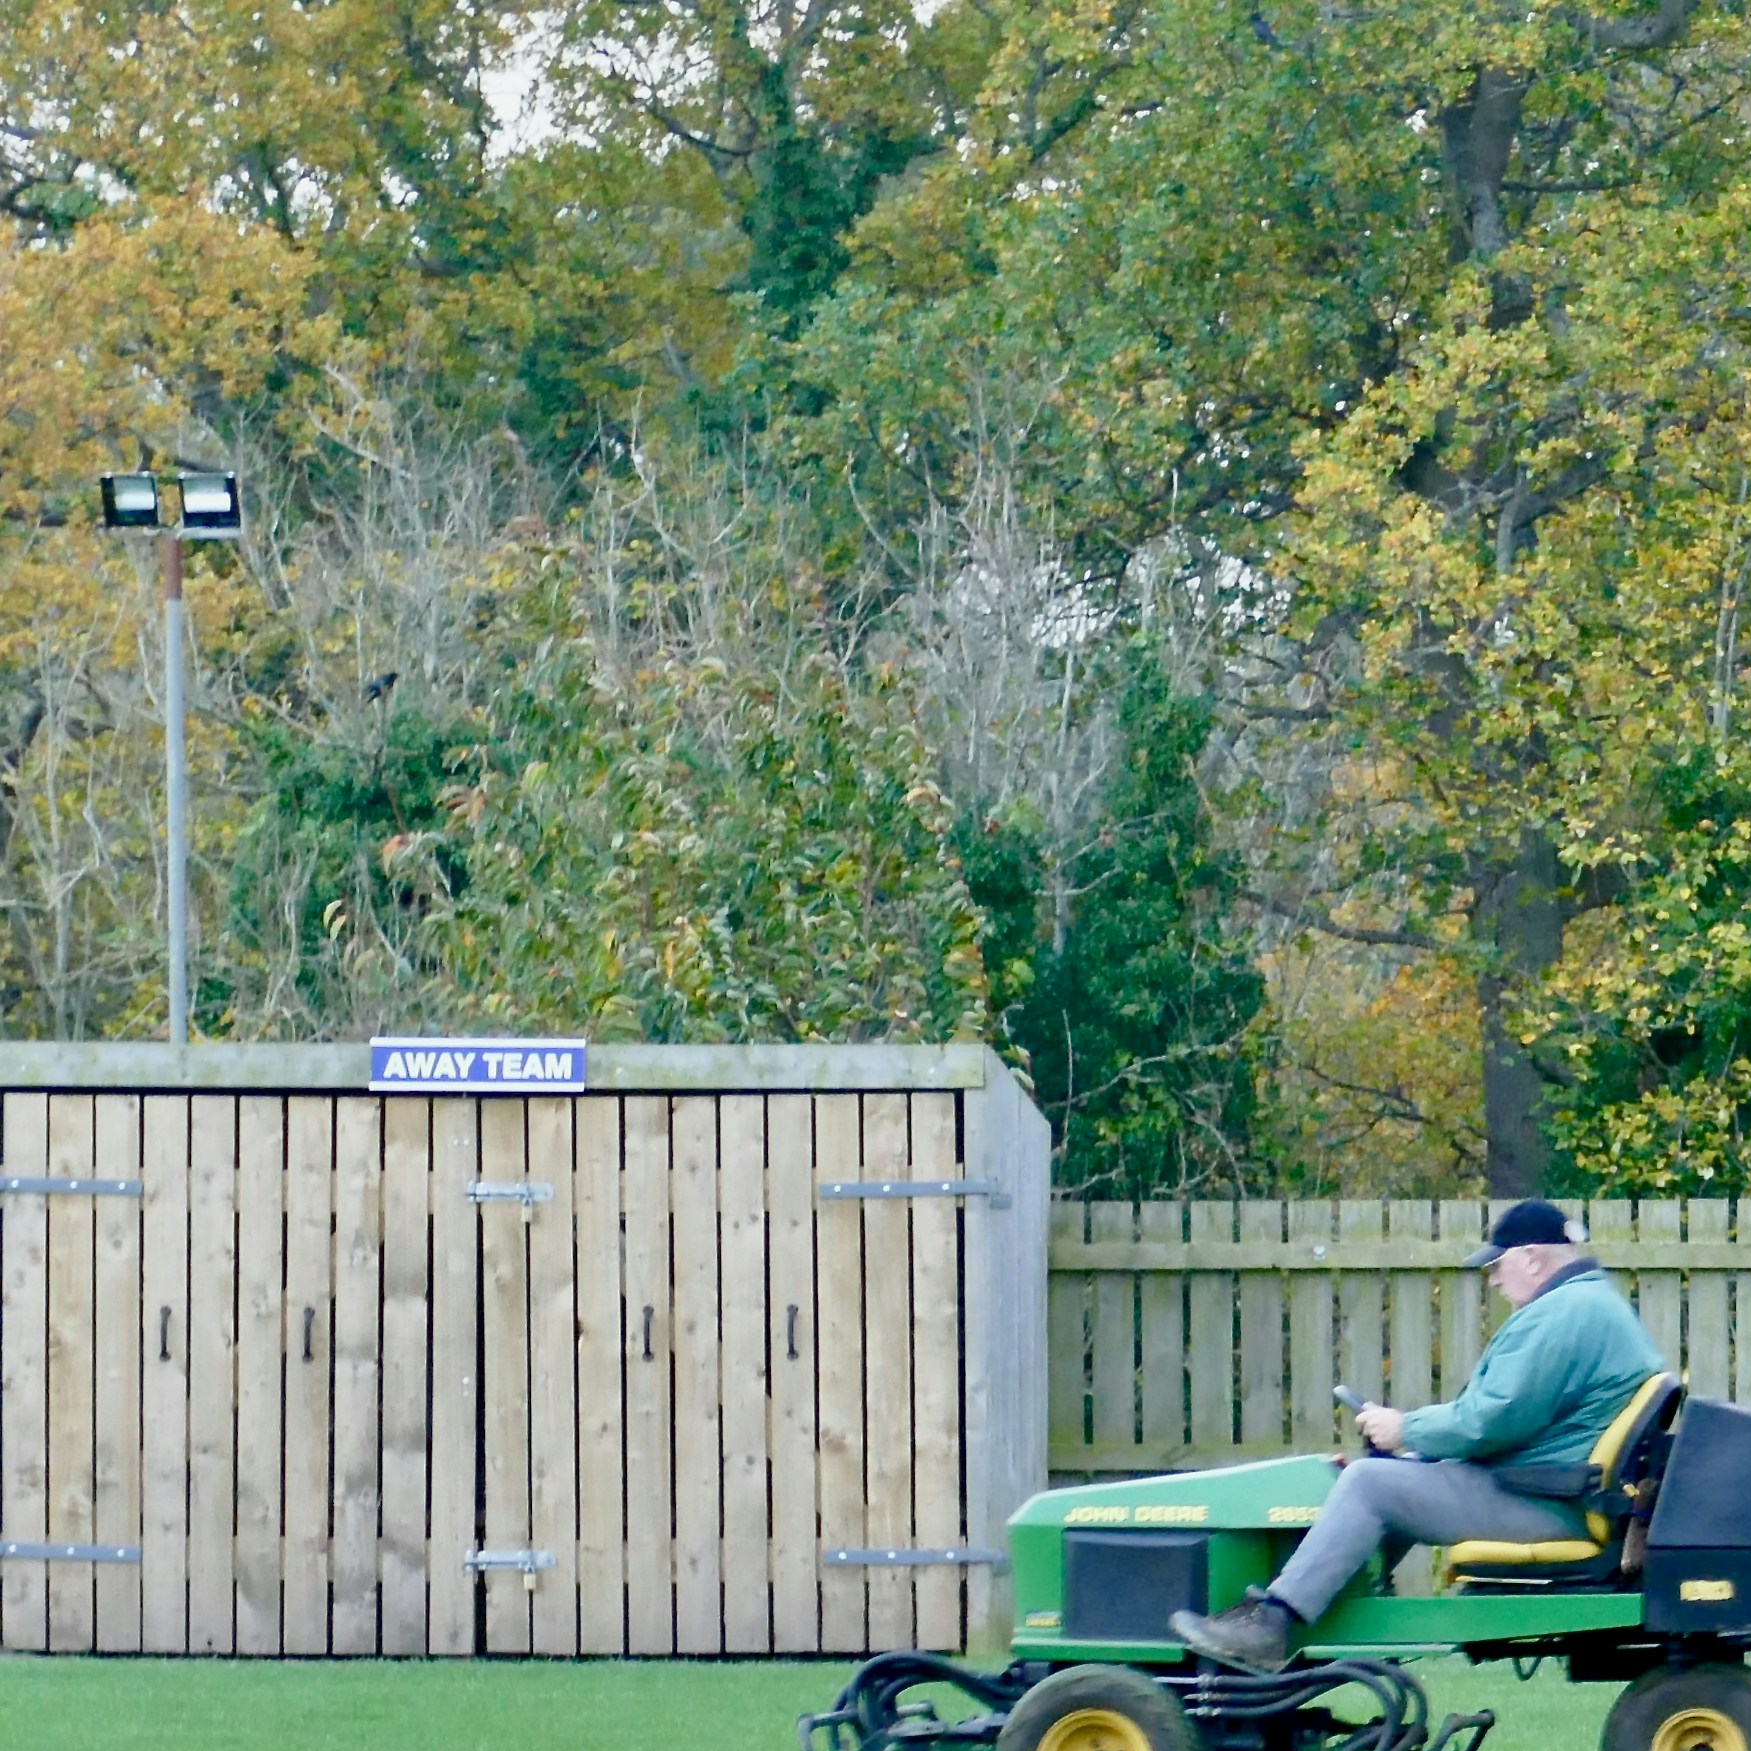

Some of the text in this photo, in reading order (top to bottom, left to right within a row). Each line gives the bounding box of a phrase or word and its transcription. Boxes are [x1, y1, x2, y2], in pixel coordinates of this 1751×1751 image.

[383, 1052, 572, 1080] AWAY TEAM
[1064, 1505, 1209, 1523] JOHN DEERE
